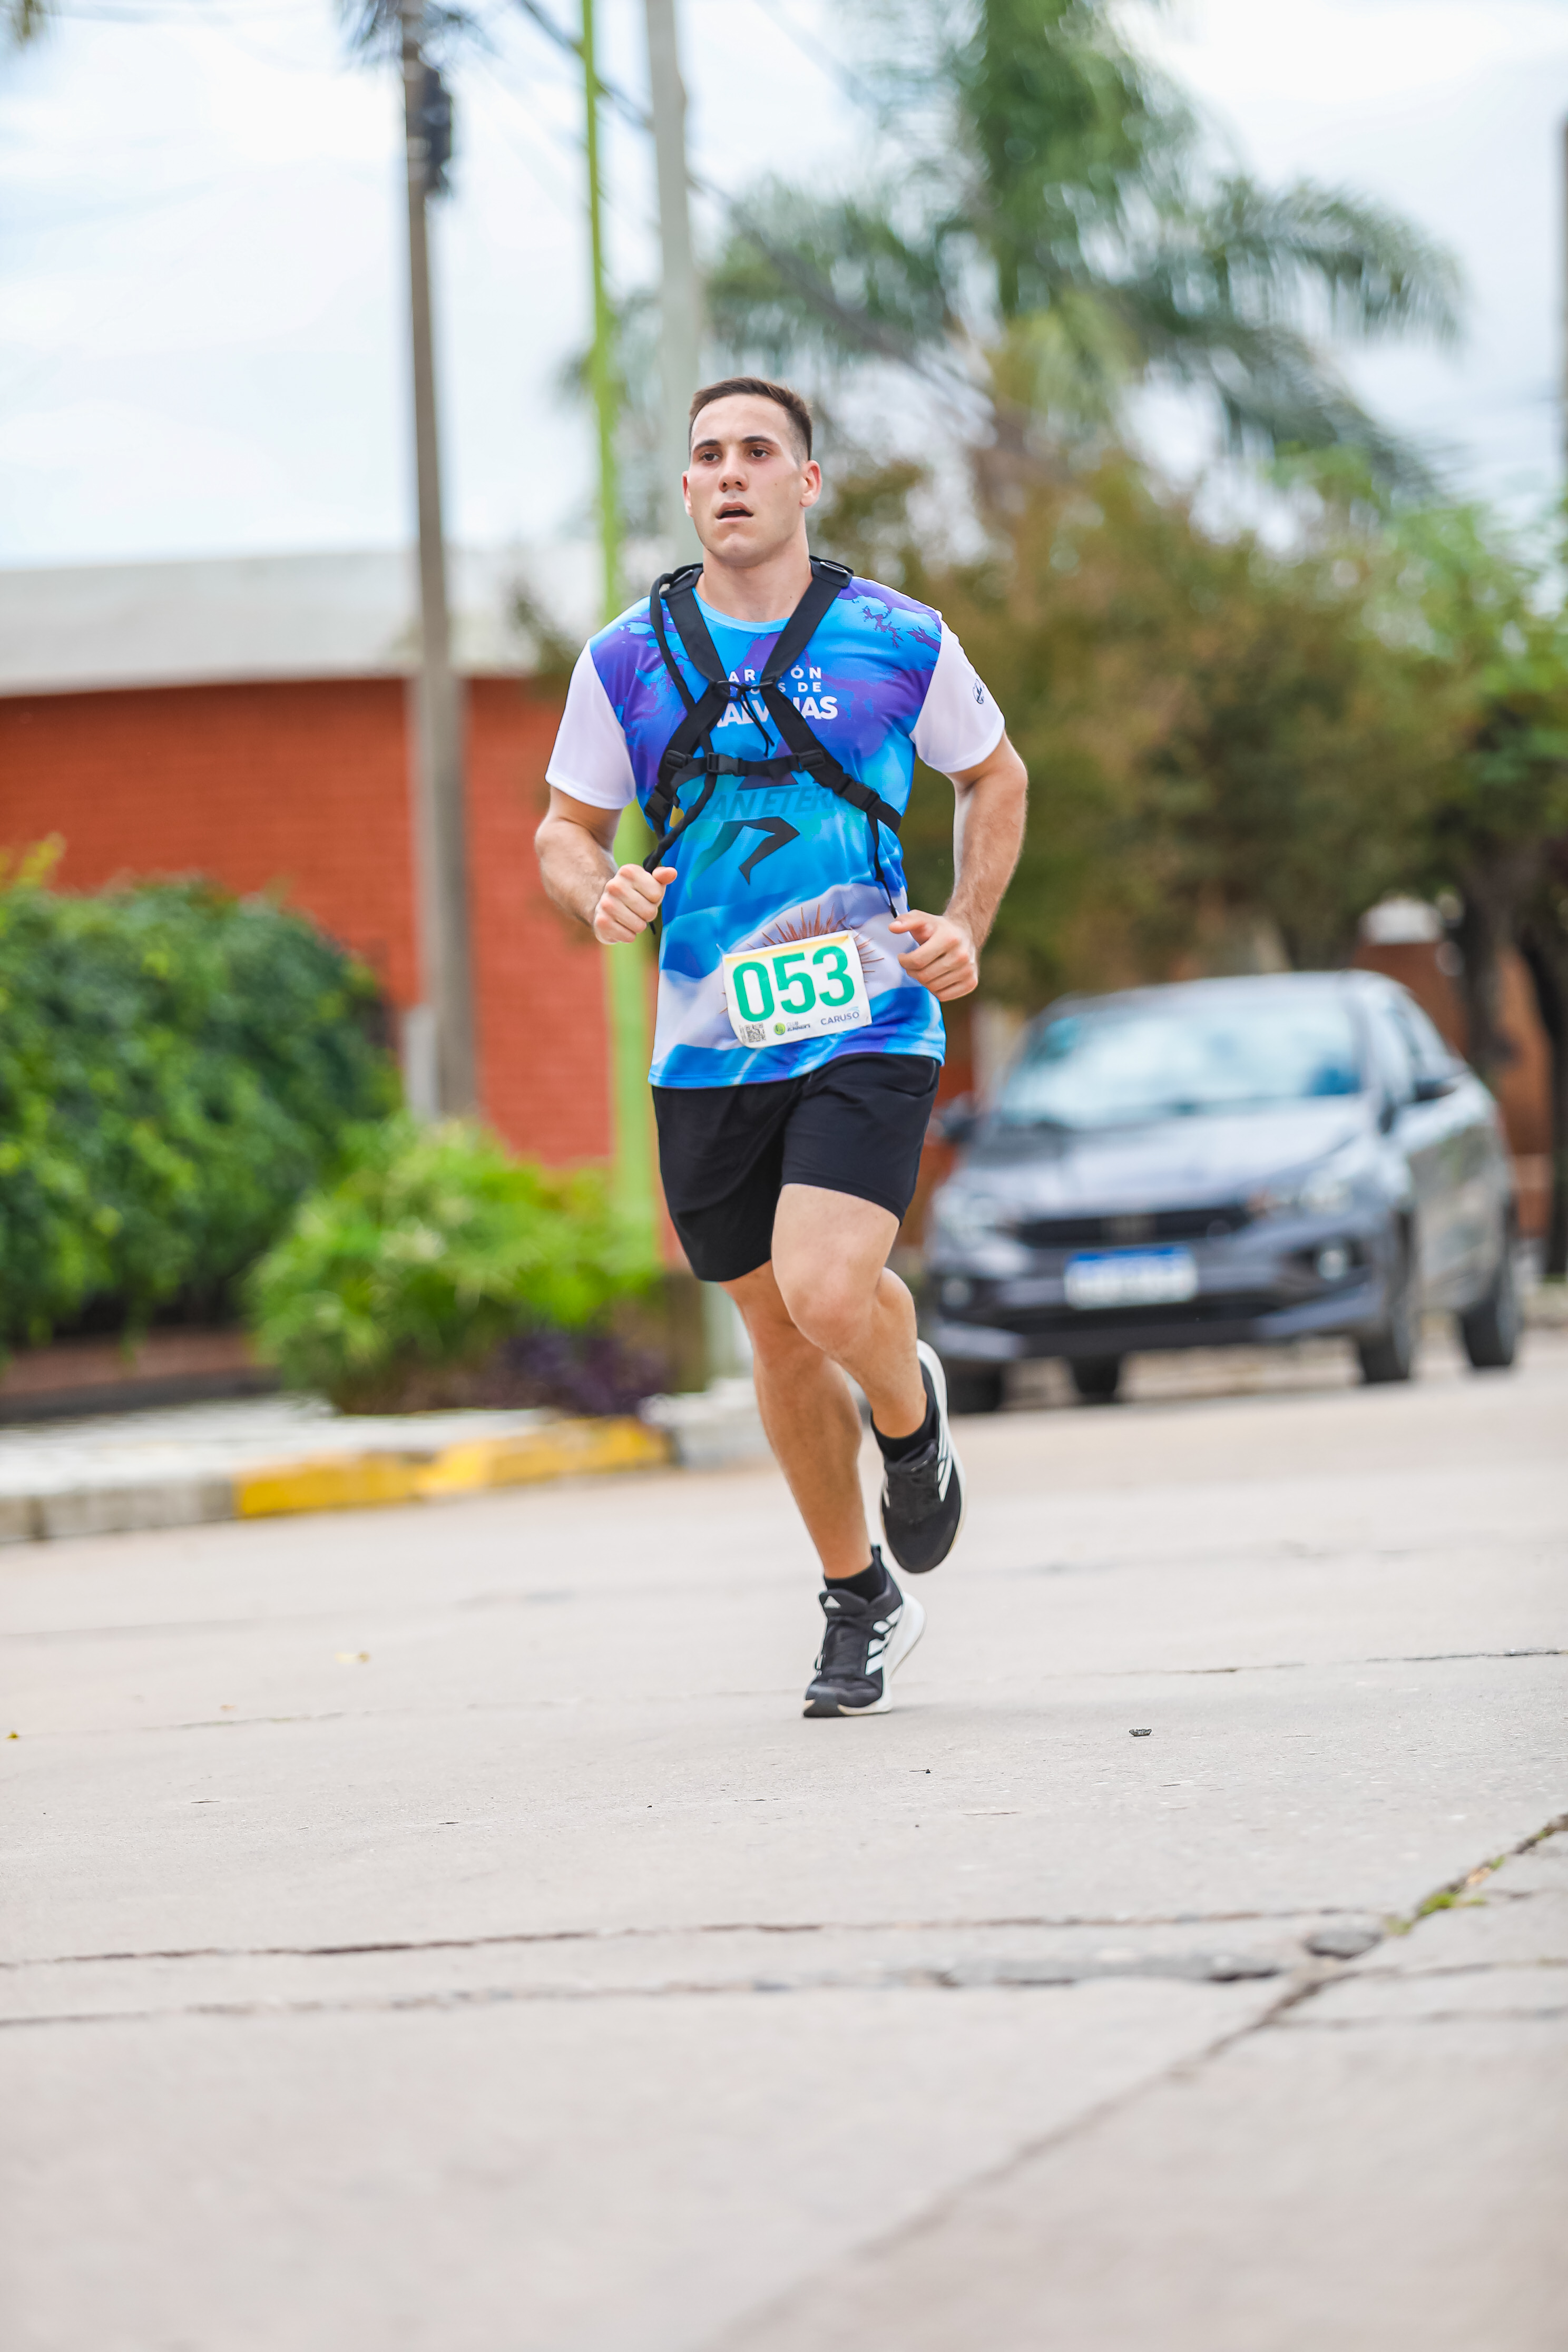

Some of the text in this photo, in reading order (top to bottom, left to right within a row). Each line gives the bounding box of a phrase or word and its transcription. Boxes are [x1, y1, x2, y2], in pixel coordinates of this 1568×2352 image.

[798, 682, 822, 692] DE
[733, 945, 855, 1022] 053
[821, 1011, 859, 1025] CARUSO
